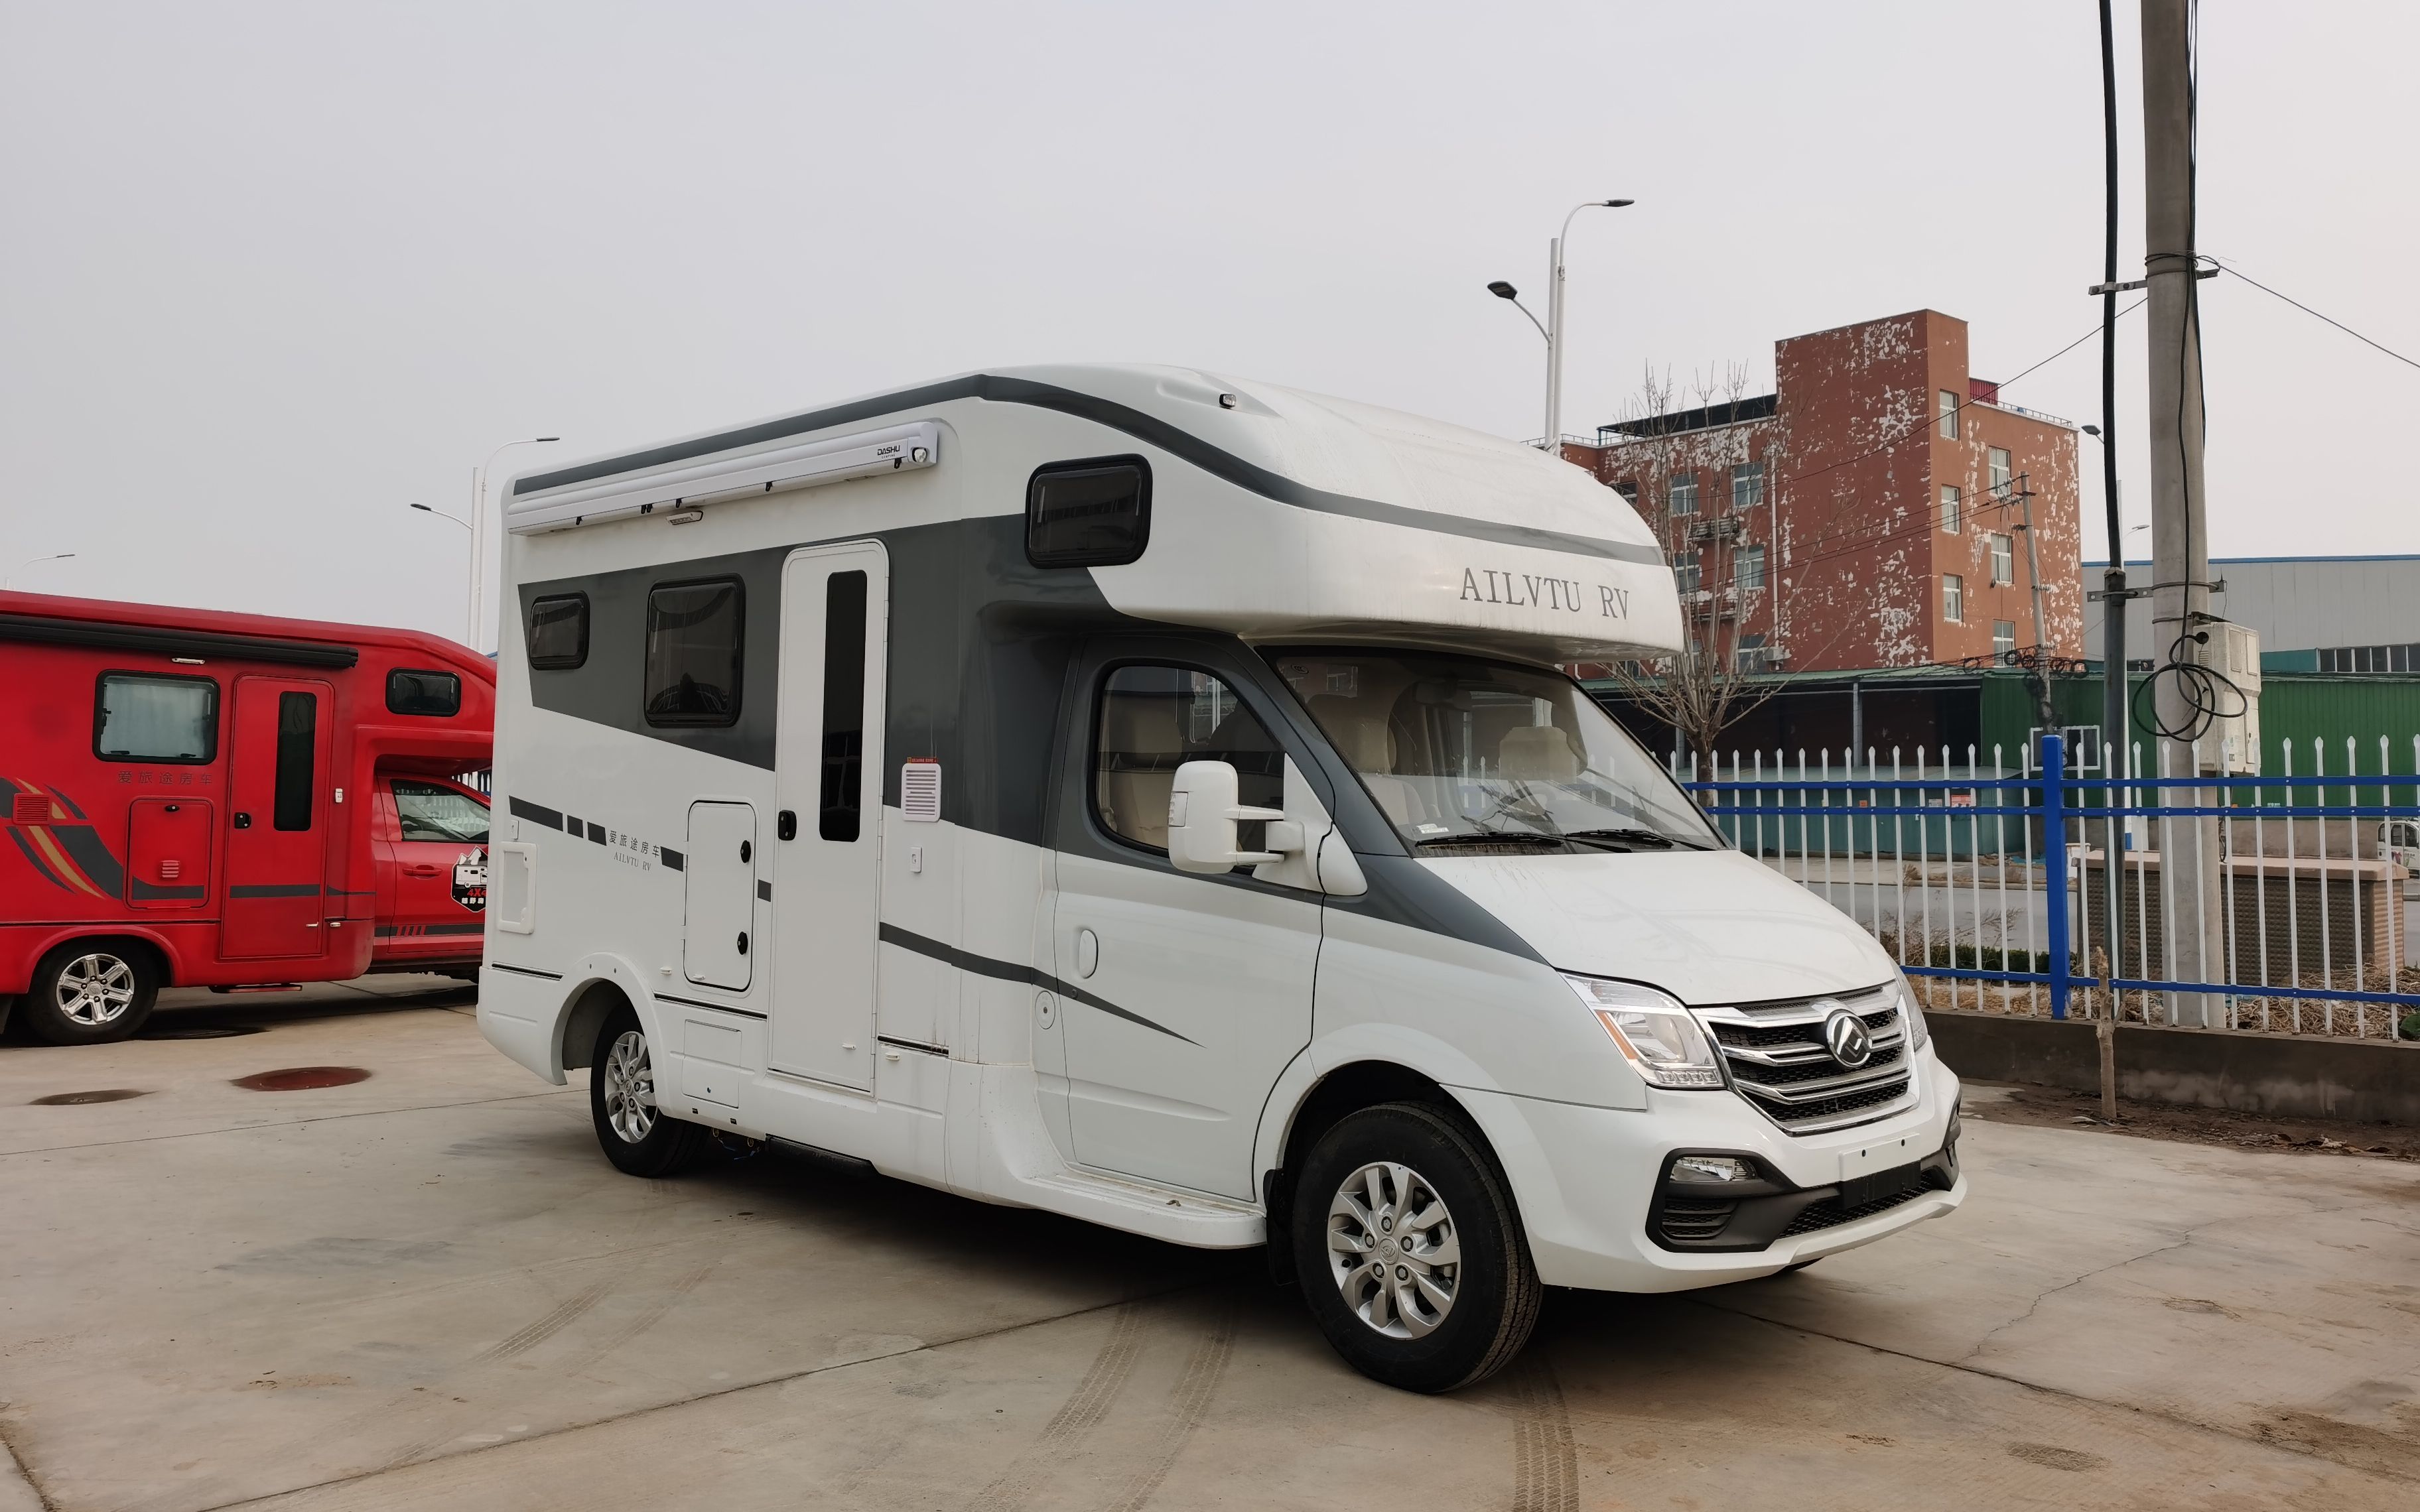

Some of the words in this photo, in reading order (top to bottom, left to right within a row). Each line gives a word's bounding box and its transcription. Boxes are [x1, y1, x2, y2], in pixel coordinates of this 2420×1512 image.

[877, 445, 900, 456] DASHU
[1459, 567, 1581, 613] AILVTU
[1597, 584, 1629, 621] RV
[117, 770, 213, 786] 爱旅途房车
[609, 830, 660, 857] 爱旅途房车
[614, 851, 639, 867] AILVTU
[642, 861, 651, 871] RV
